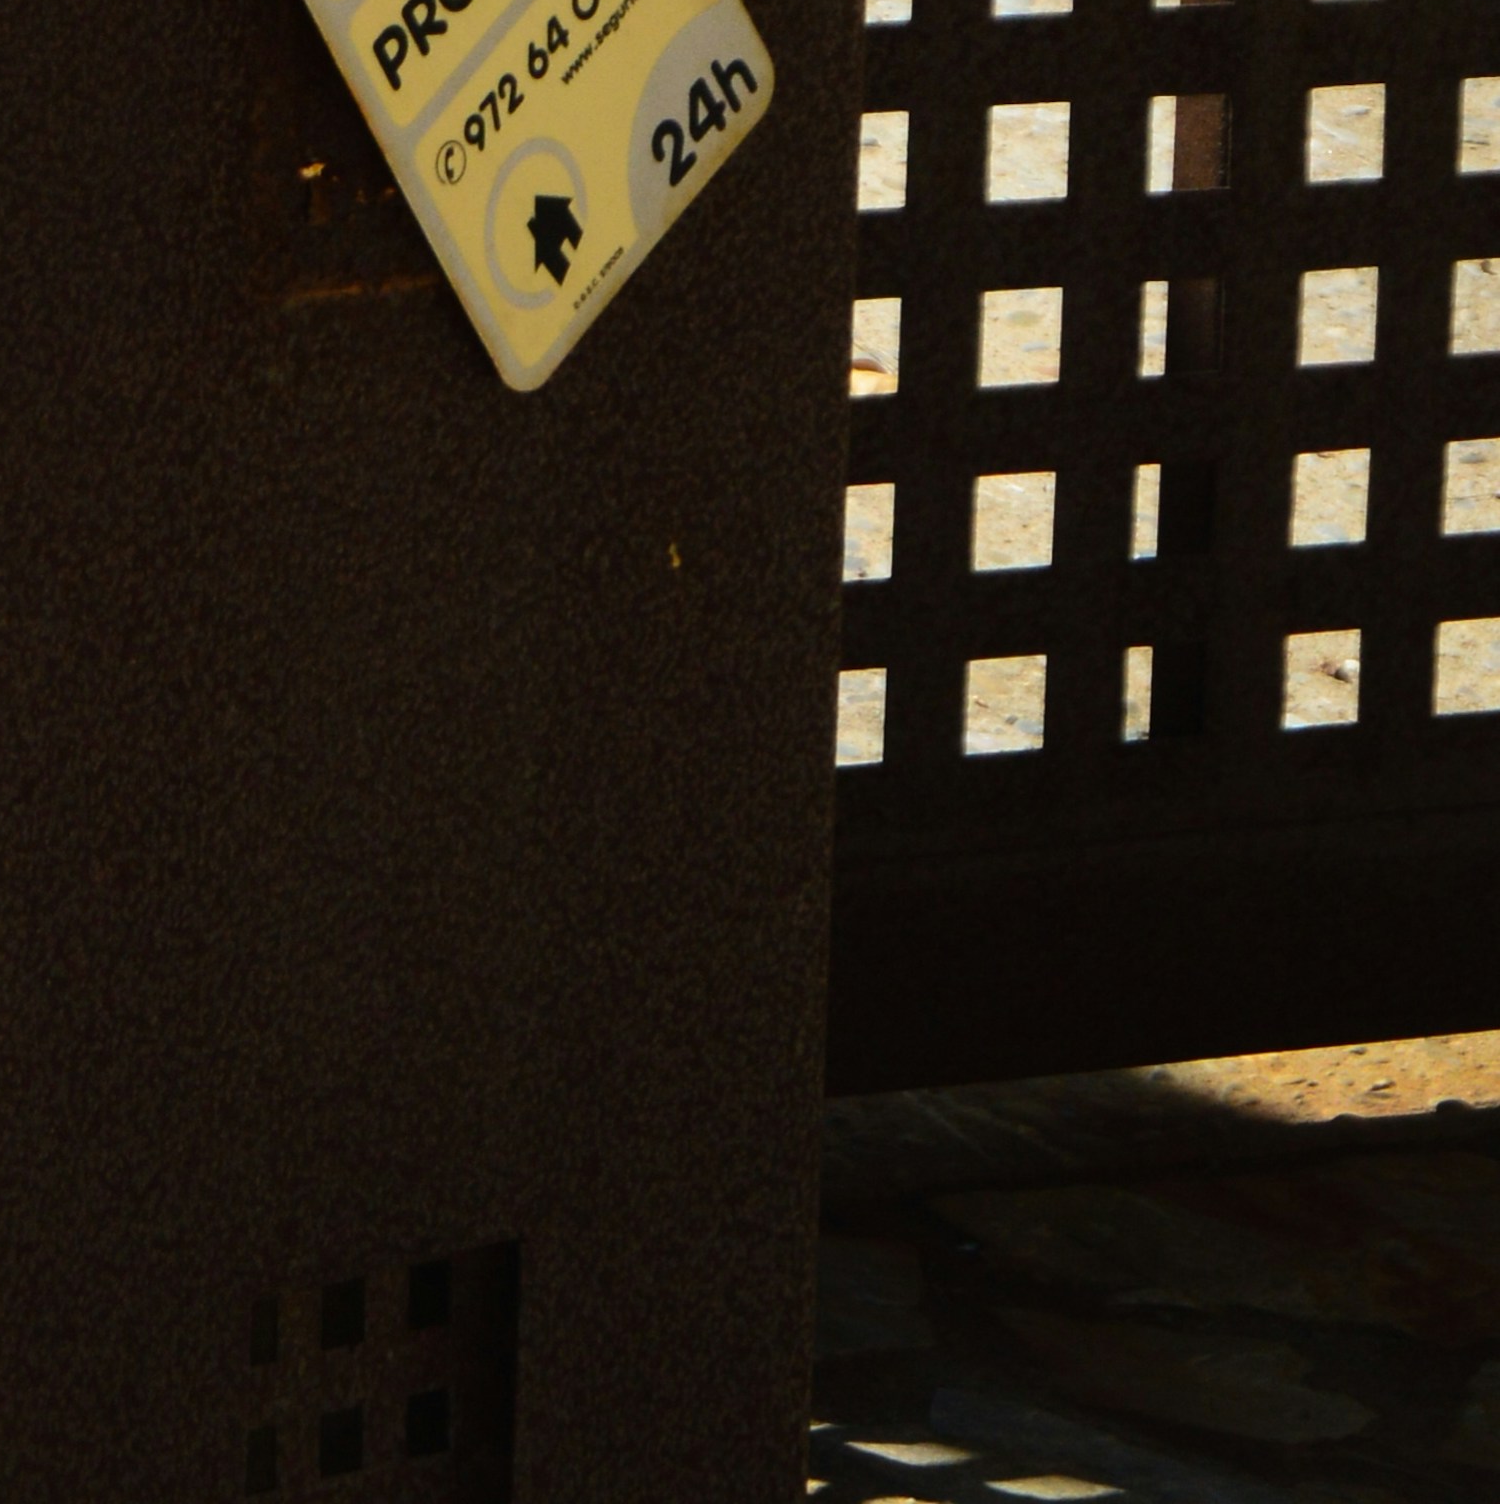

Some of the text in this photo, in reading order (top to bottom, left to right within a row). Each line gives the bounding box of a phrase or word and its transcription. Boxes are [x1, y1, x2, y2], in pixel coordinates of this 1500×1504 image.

[464, 73, 524, 152] 972
[528, 16, 569, 79] 64
[651, 57, 758, 187] 24h
